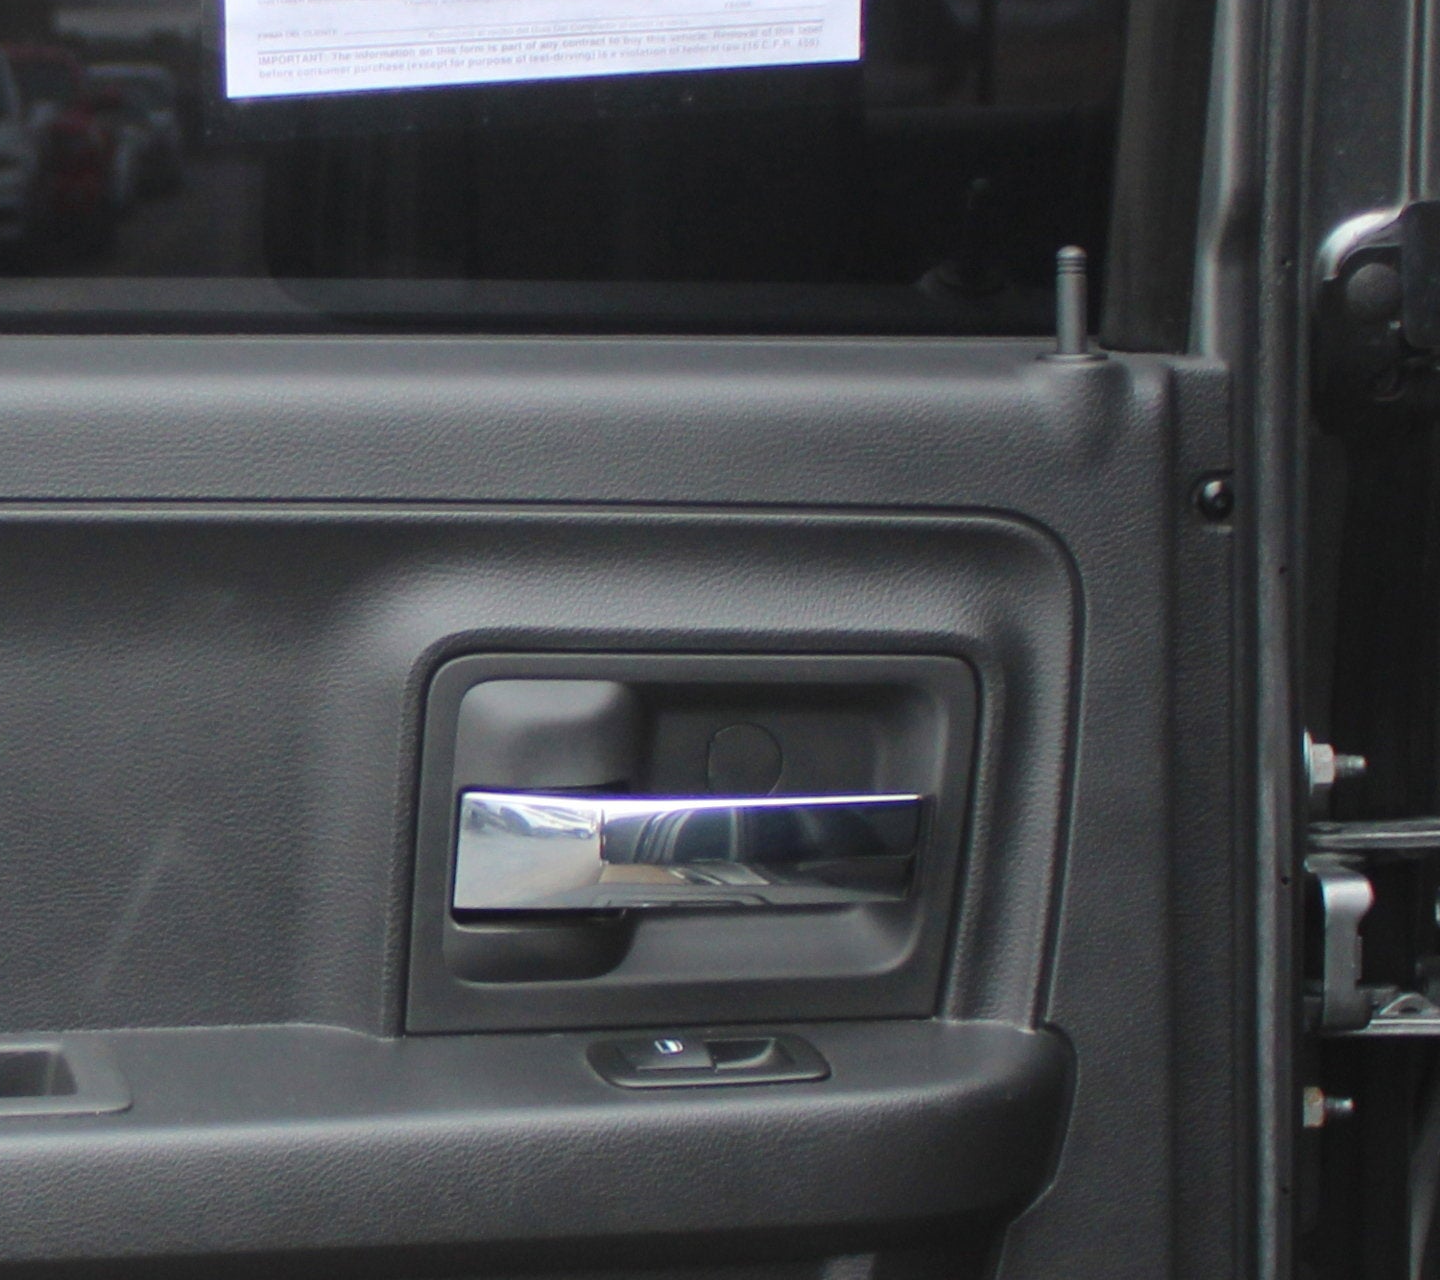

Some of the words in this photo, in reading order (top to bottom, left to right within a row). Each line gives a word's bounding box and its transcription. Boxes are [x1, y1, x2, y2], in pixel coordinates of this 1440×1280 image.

[259, 68, 293, 79] before
[296, 66, 351, 78] consumer
[354, 61, 405, 76] purchase
[449, 58, 466, 69] for
[467, 55, 512, 69] purpose
[515, 53, 526, 64] of
[619, 46, 666, 59] violation
[668, 44, 679, 55] of
[682, 42, 720, 55] federal
[333, 51, 352, 62] The
[355, 48, 416, 60] information
[419, 48, 434, 57] on
[436, 45, 456, 56] this
[460, 44, 484, 55] form
[487, 43, 497, 53] is
[501, 41, 523, 54] part
[526, 40, 537, 51] of
[539, 40, 558, 52] any
[562, 37, 606, 50] contract
[609, 36, 620, 47] to
[623, 35, 642, 47] buy
[646, 33, 666, 44] this
[713, 27, 758, 40] Removal
[761, 26, 772, 37] of
[774, 24, 794, 36] this
[798, 23, 823, 35] label
